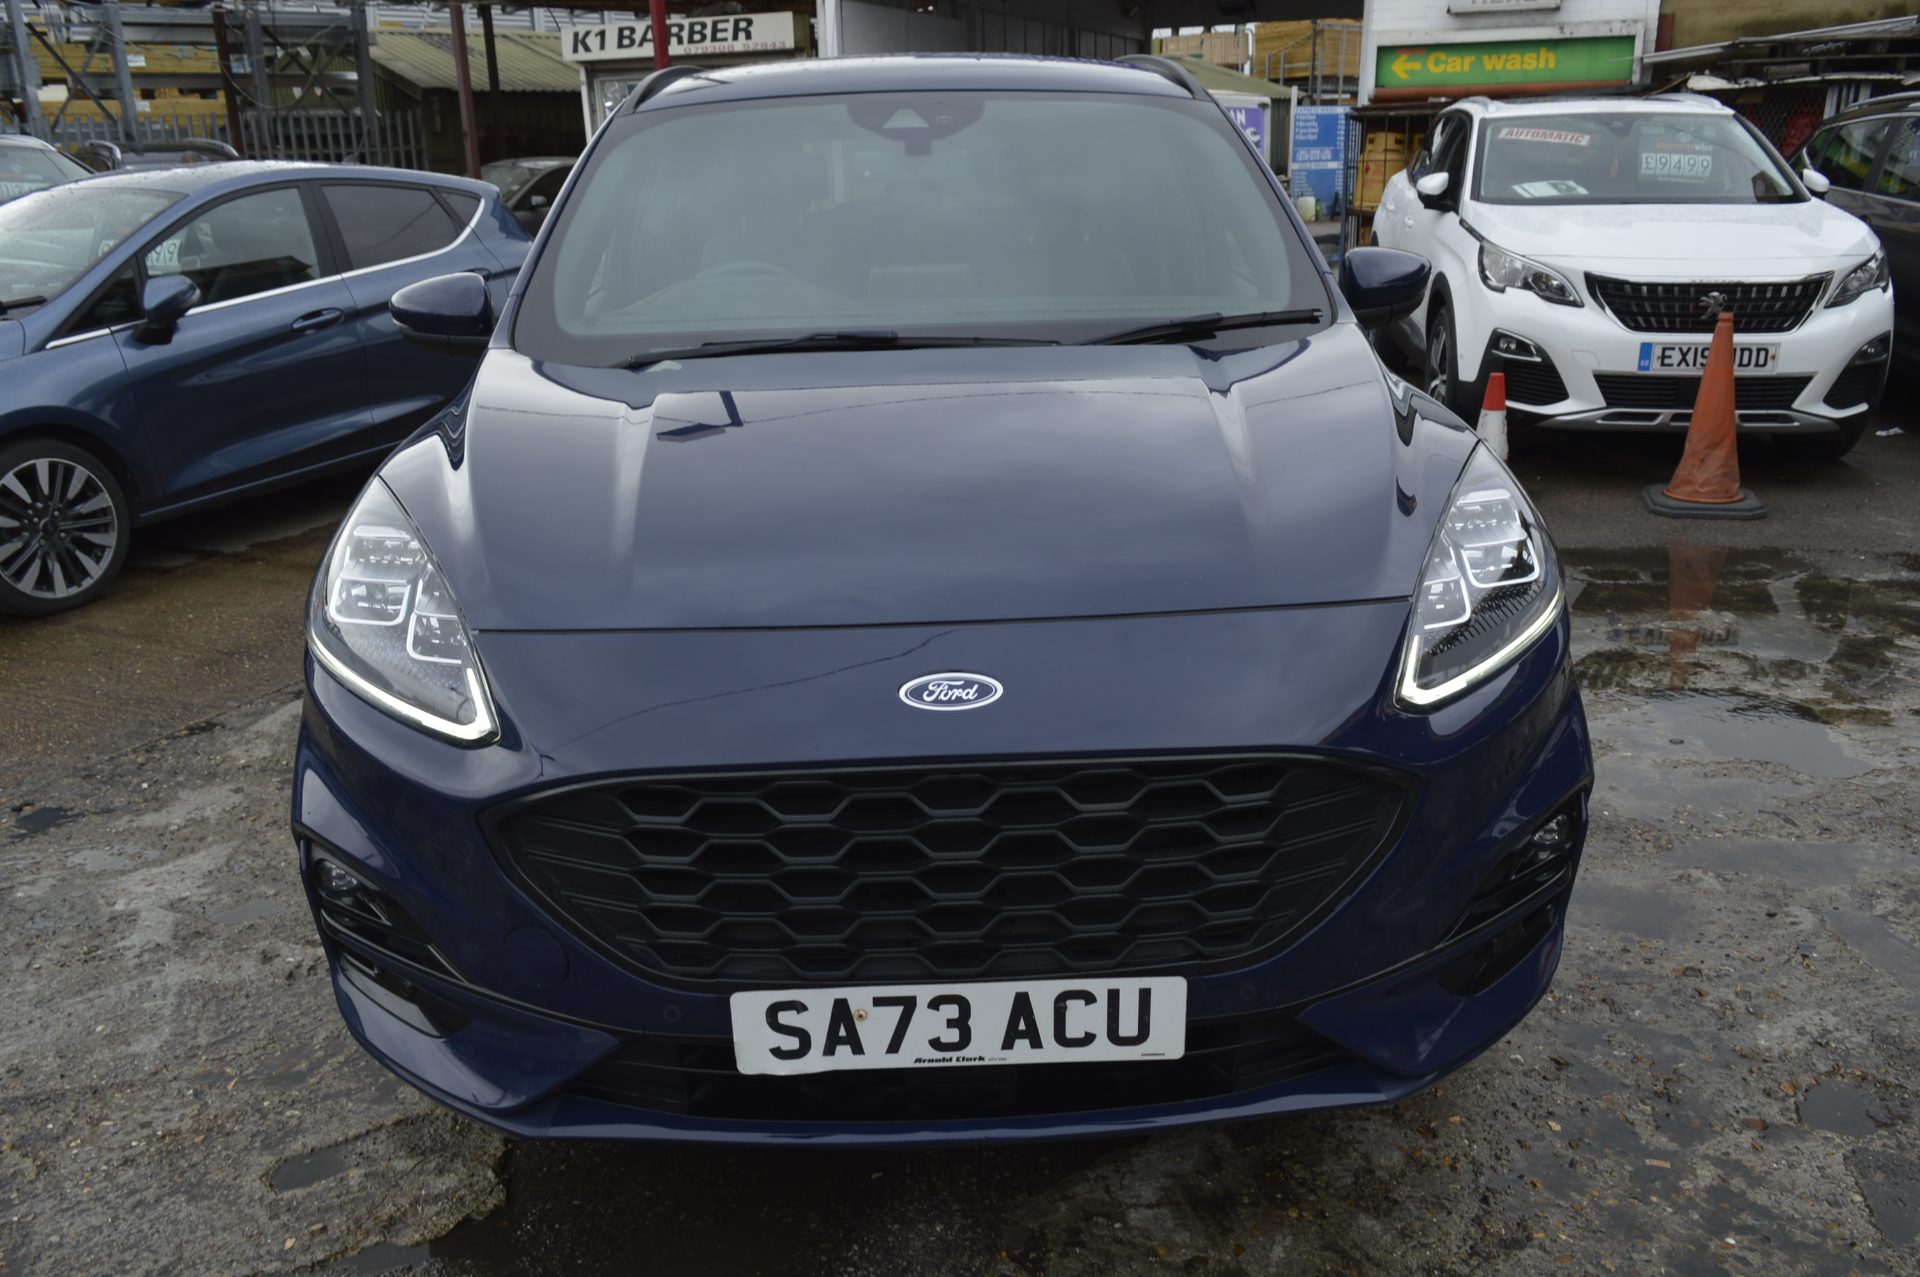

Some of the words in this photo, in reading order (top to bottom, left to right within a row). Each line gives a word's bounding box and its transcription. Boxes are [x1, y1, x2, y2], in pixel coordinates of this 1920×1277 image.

[572, 29, 606, 54] K1
[617, 17, 754, 49] BARBER
[1427, 51, 1475, 74] Car
[1483, 47, 1556, 72] wash
[1505, 128, 1585, 144] AUTOMATIC
[1643, 155, 1710, 174] £9499
[922, 680, 979, 702] Ford
[765, 994, 972, 1061] SA73
[1001, 987, 1152, 1051] ACU
[913, 1056, 953, 1064] Arnold
[956, 1055, 986, 1063] Clark
